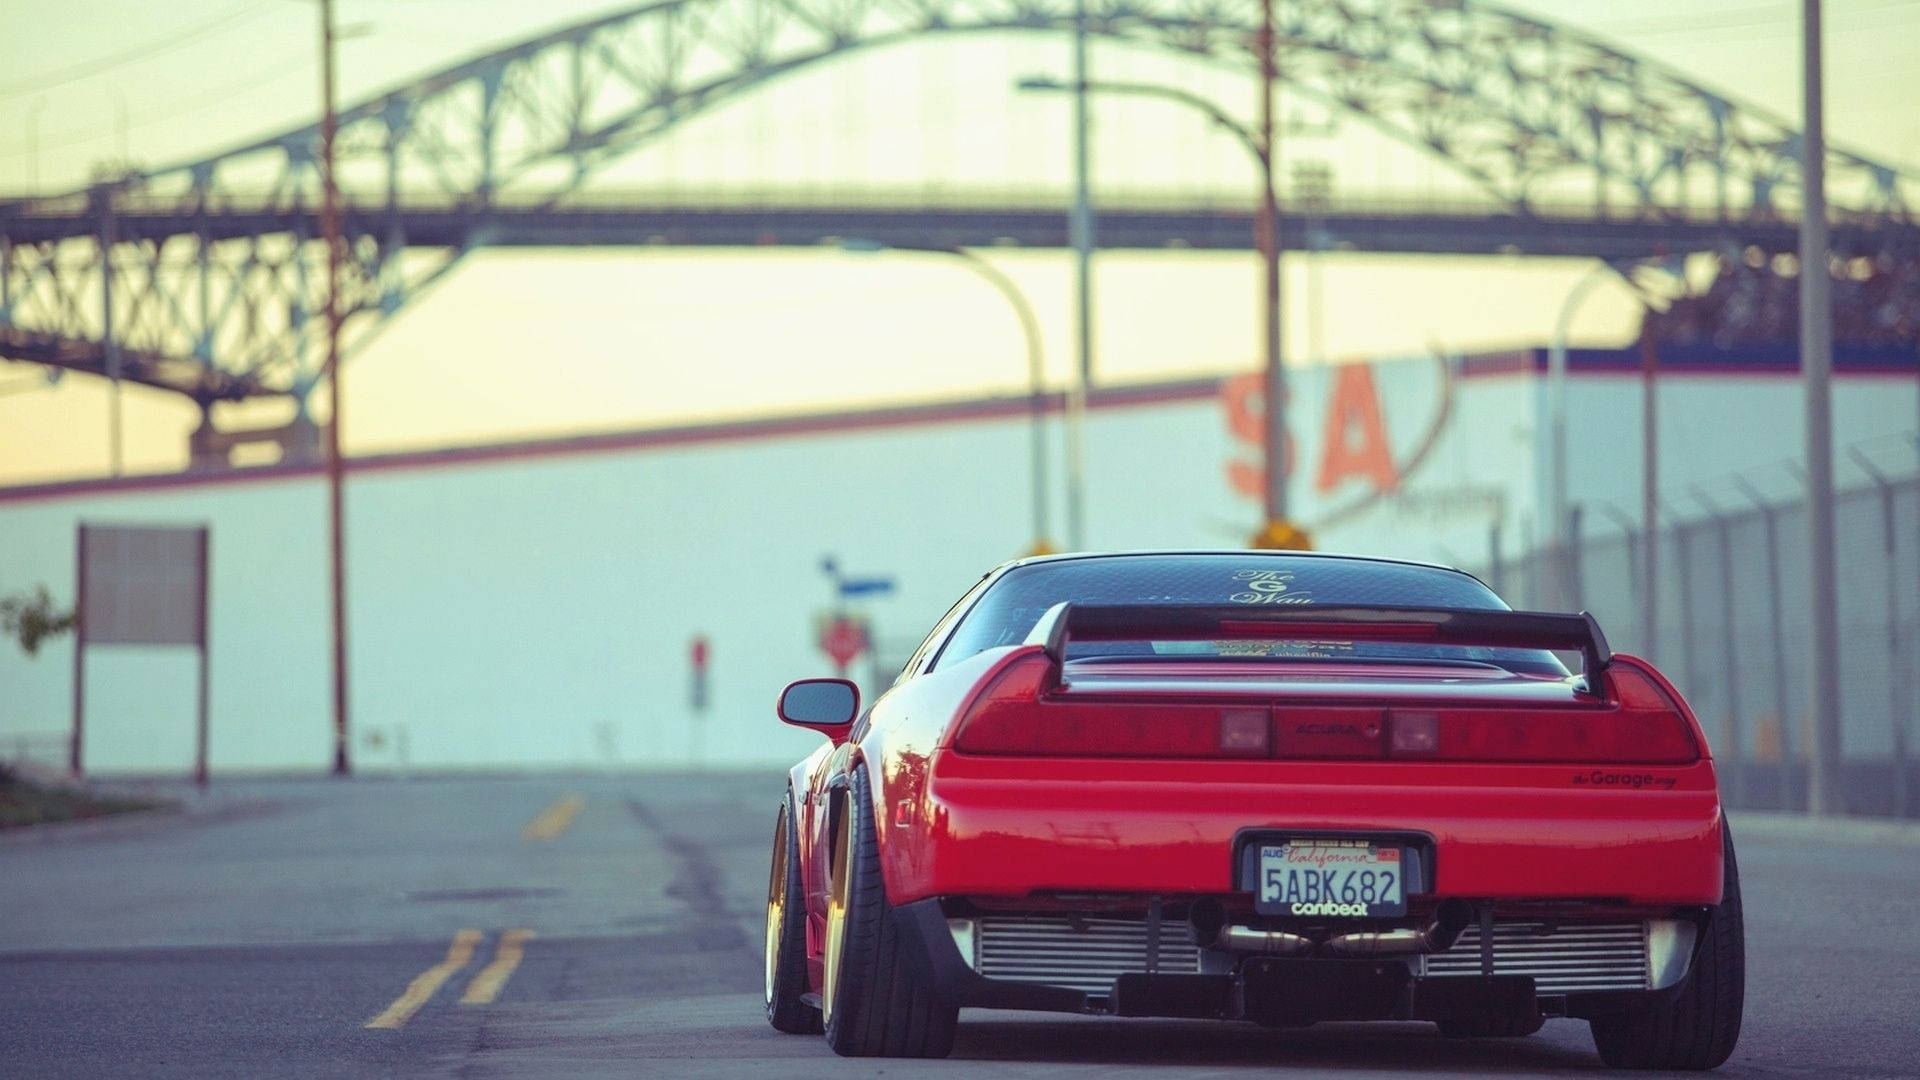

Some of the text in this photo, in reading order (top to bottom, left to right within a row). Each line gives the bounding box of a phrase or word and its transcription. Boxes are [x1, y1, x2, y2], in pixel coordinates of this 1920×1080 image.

[1232, 570, 1295, 581] The
[1249, 580, 1287, 592] G
[1296, 724, 1358, 734] ACURA
[1590, 771, 1654, 788] Garage
[1262, 849, 1284, 859] AUG
[1287, 848, 1377, 867] California
[1266, 869, 1395, 903] 5ABK682
